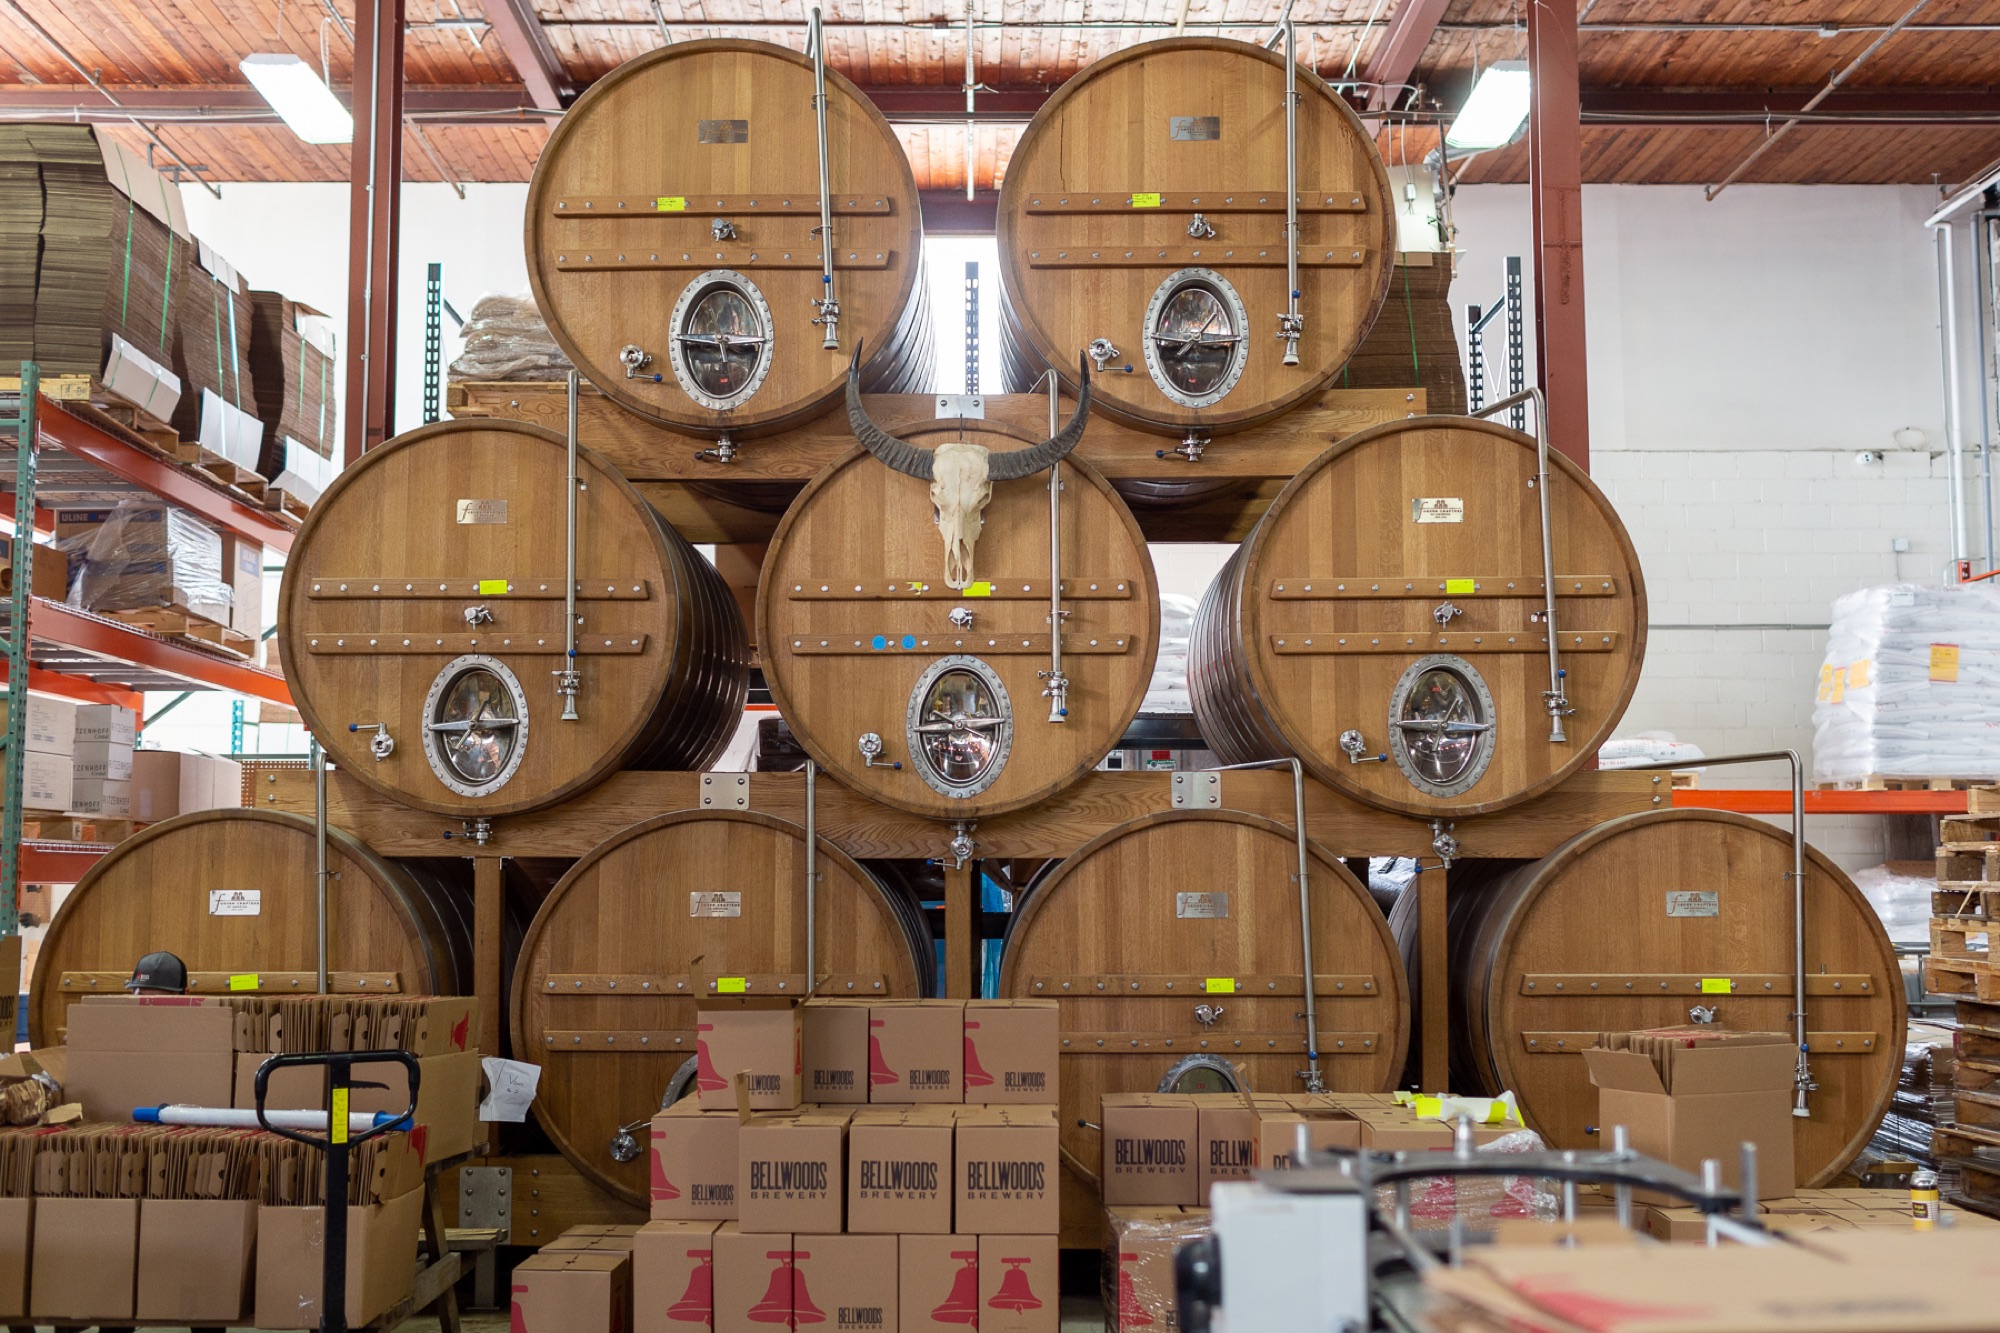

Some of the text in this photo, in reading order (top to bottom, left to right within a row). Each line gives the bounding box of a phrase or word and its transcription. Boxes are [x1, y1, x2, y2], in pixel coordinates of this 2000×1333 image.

[61, 513, 89, 522] ULINE
[745, 1074, 780, 1091] LLWOODS
[813, 1069, 854, 1086] BELLWOODS
[909, 1069, 950, 1085] BELLWOODS
[1004, 1071, 1046, 1087] BELLWOODS
[1115, 1139, 1186, 1165] BELLWOODS
[1210, 1139, 1253, 1166] BELLW
[750, 1161, 828, 1190] BELLWOODS
[860, 1160, 938, 1190] BELLWOODS
[967, 1161, 1045, 1191] BELLWOODS
[1115, 1166, 1186, 1174] BREWERY
[1210, 1167, 1251, 1175] BREW
[691, 1184, 734, 1201] BELLWOODS
[750, 1191, 828, 1200] BREWERY
[860, 1191, 938, 1200] BREWERY
[967, 1191, 1045, 1200] BREWERY
[838, 1307, 882, 1324] BELLWOODS
